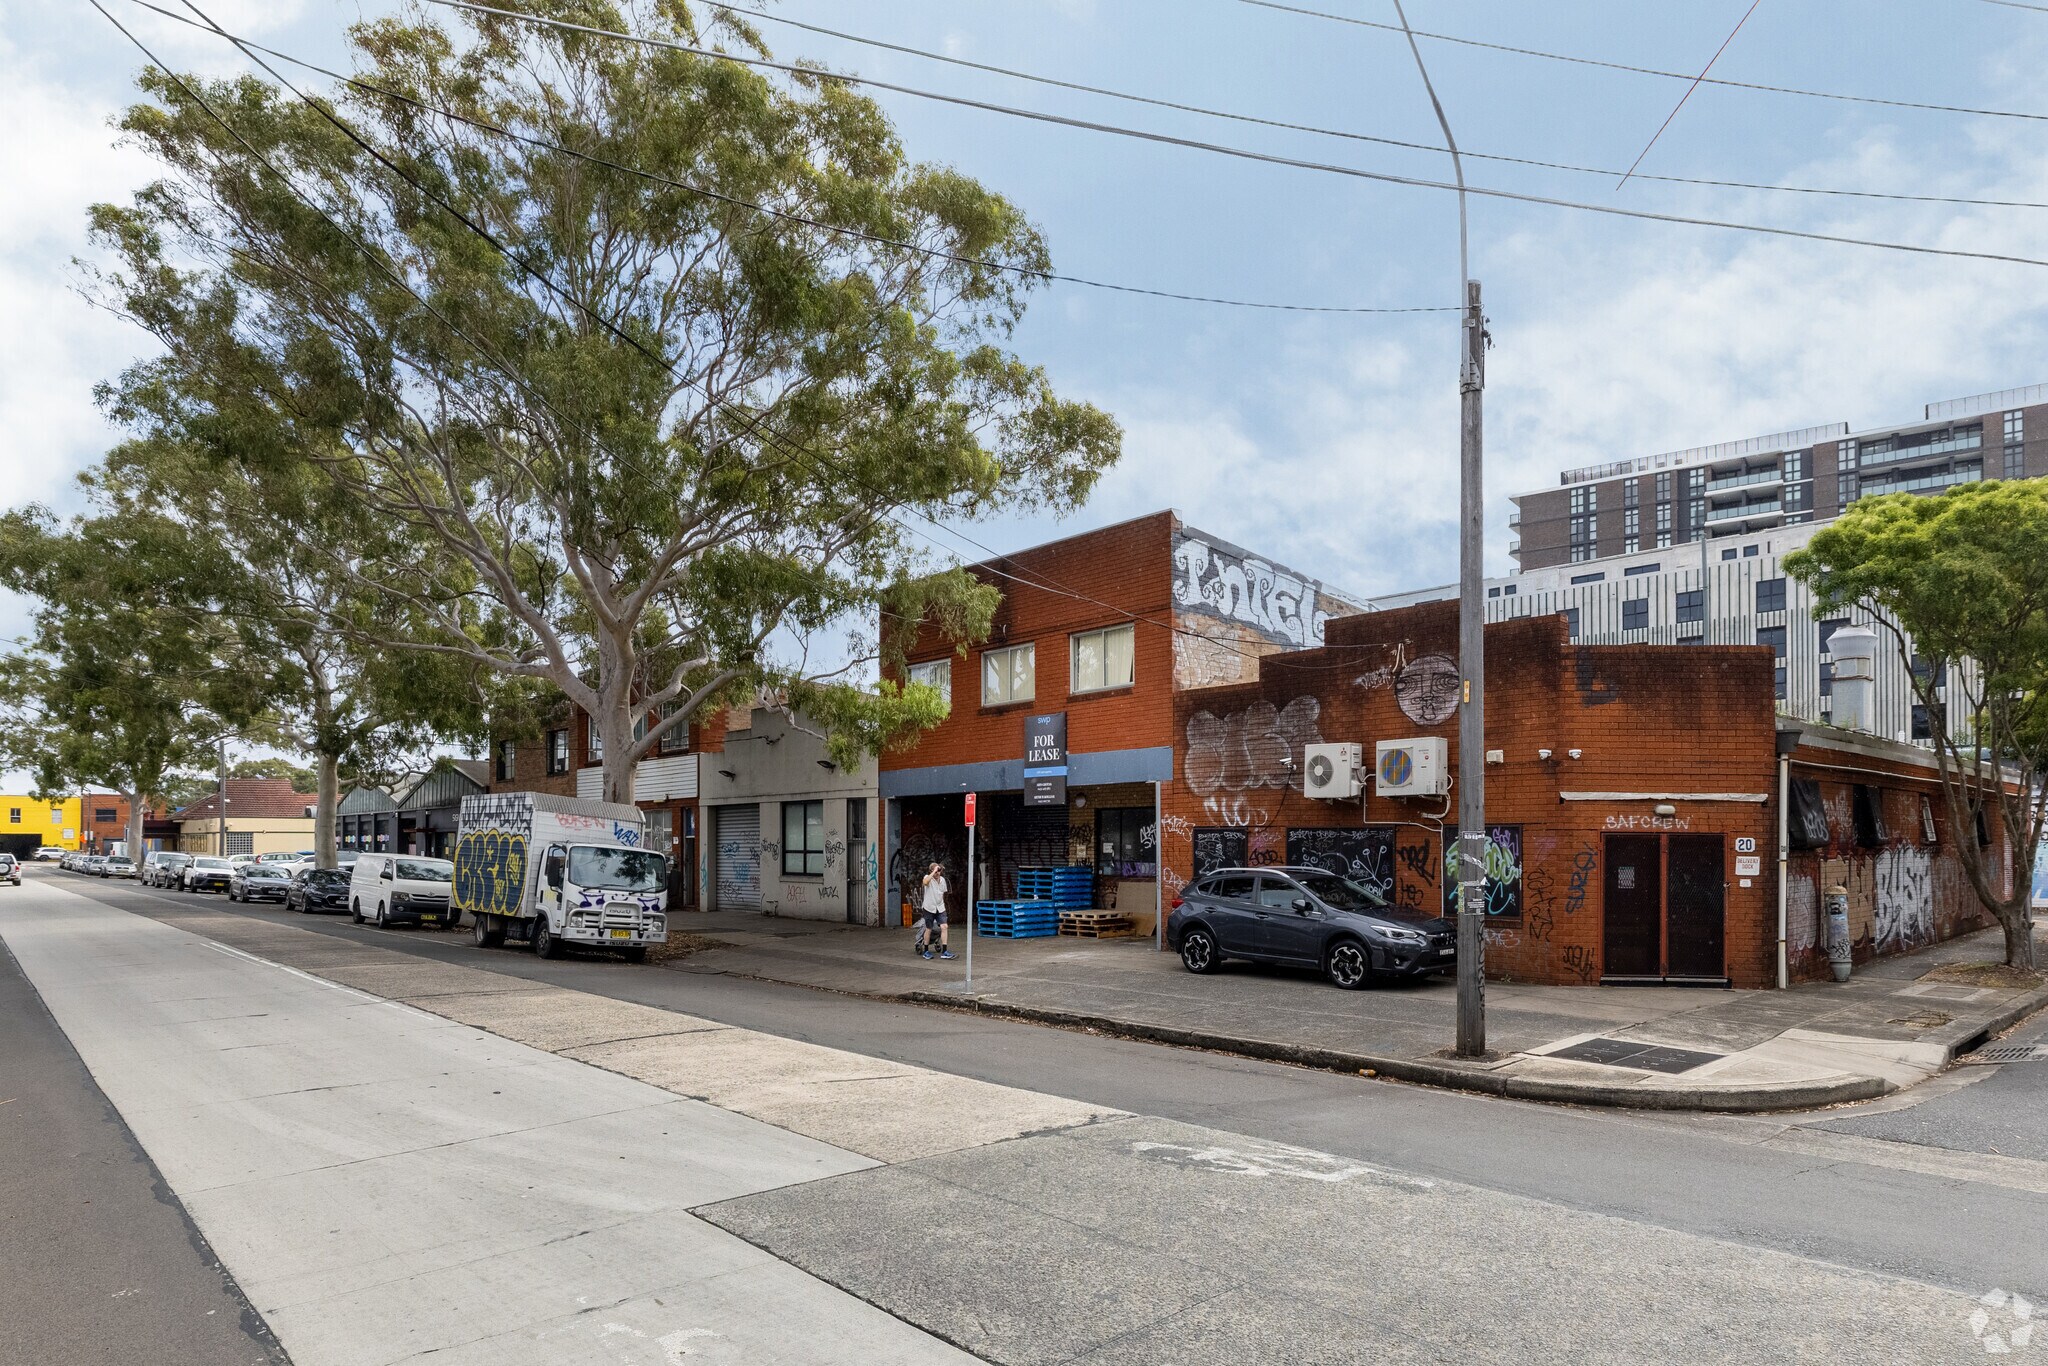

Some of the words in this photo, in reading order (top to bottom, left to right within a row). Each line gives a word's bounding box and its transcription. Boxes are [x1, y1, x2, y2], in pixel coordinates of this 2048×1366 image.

[1034, 734, 1055, 748] FOR
[1029, 748, 1060, 762] LEASE
[1738, 839, 1752, 851] 20
